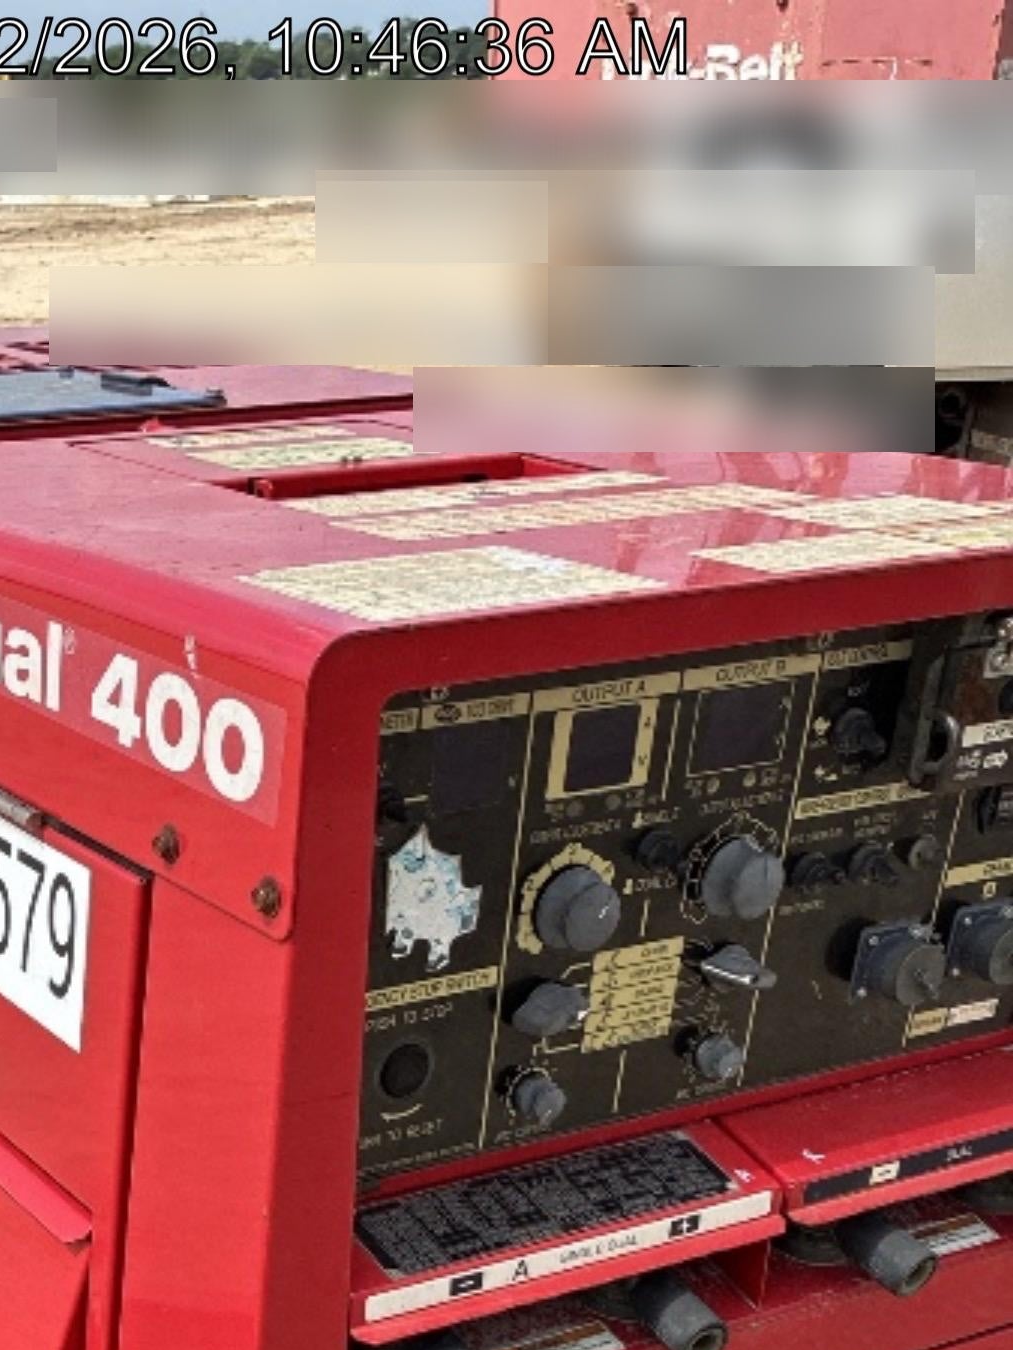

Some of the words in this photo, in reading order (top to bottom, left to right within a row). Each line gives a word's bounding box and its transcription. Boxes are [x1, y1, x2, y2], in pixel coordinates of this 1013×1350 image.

[571, 680, 633, 703] OUTPUT
[90, 652, 265, 802] 400
[512, 1259, 529, 1281] A
